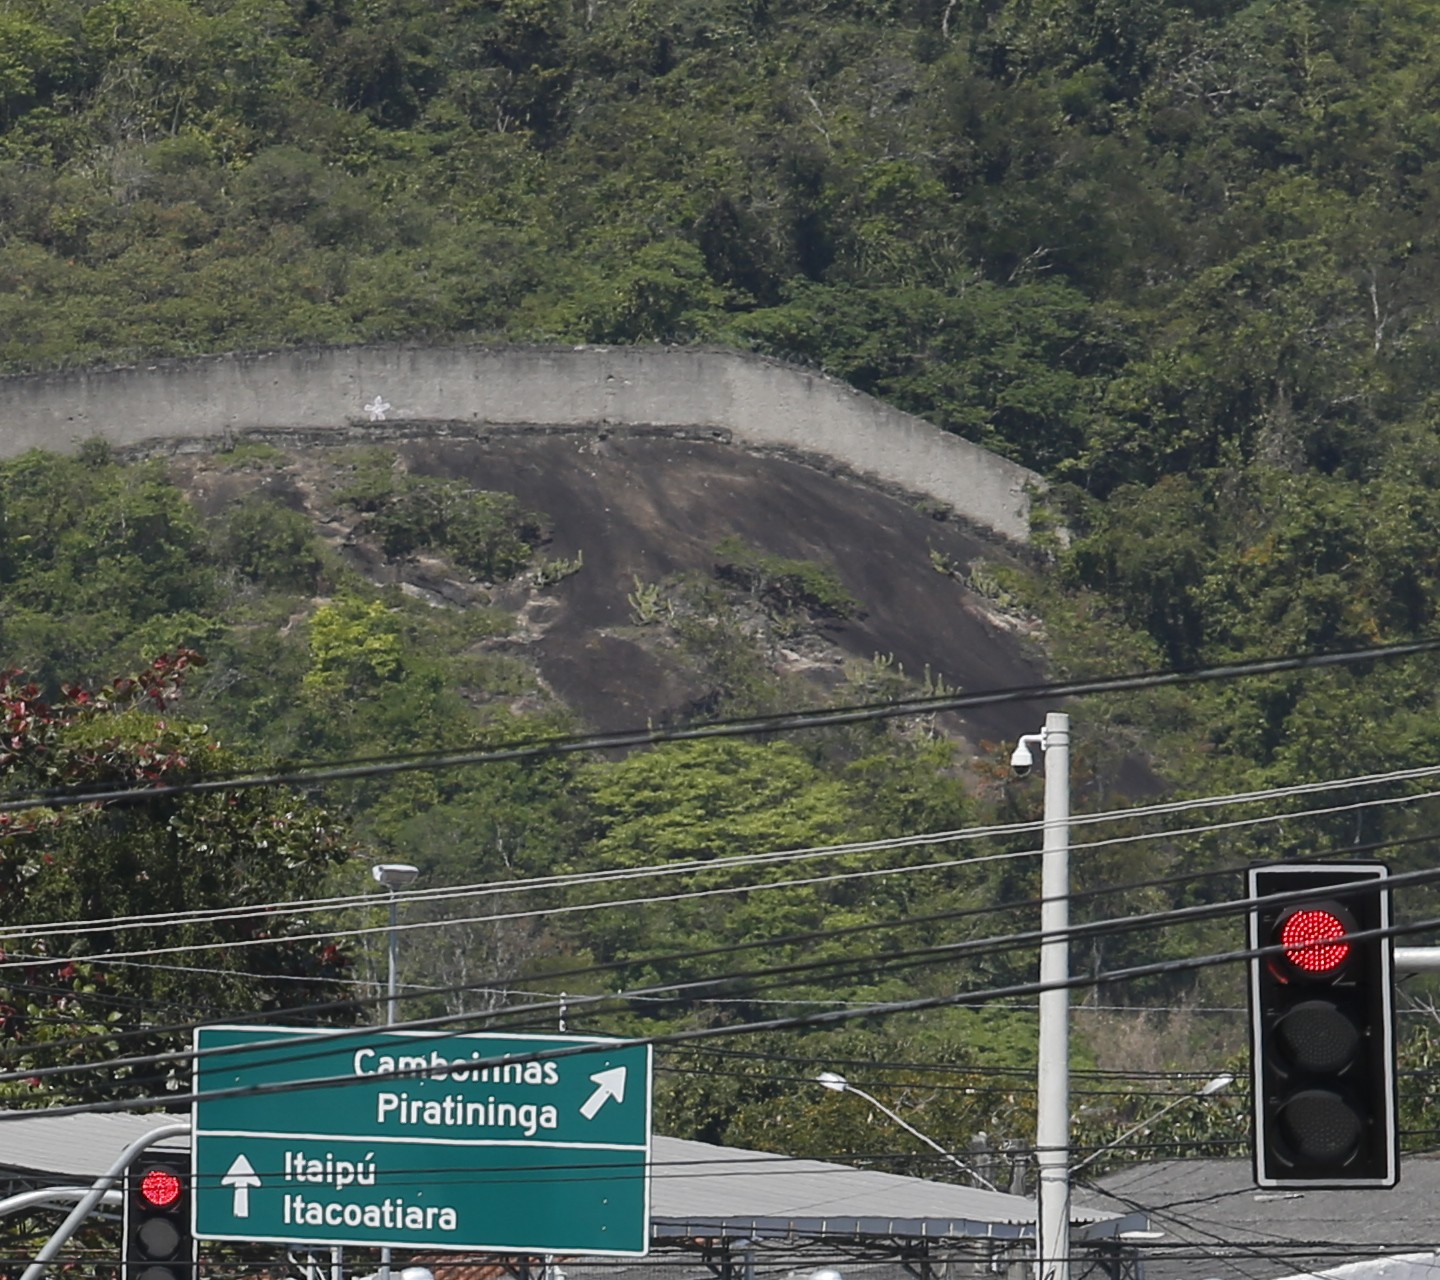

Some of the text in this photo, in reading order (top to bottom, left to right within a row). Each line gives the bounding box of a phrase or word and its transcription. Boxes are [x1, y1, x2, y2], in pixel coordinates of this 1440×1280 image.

[376, 1091, 558, 1136] Piratininga
[284, 1150, 377, 1191] Itaipú
[282, 1193, 459, 1231] Itacoatiara
